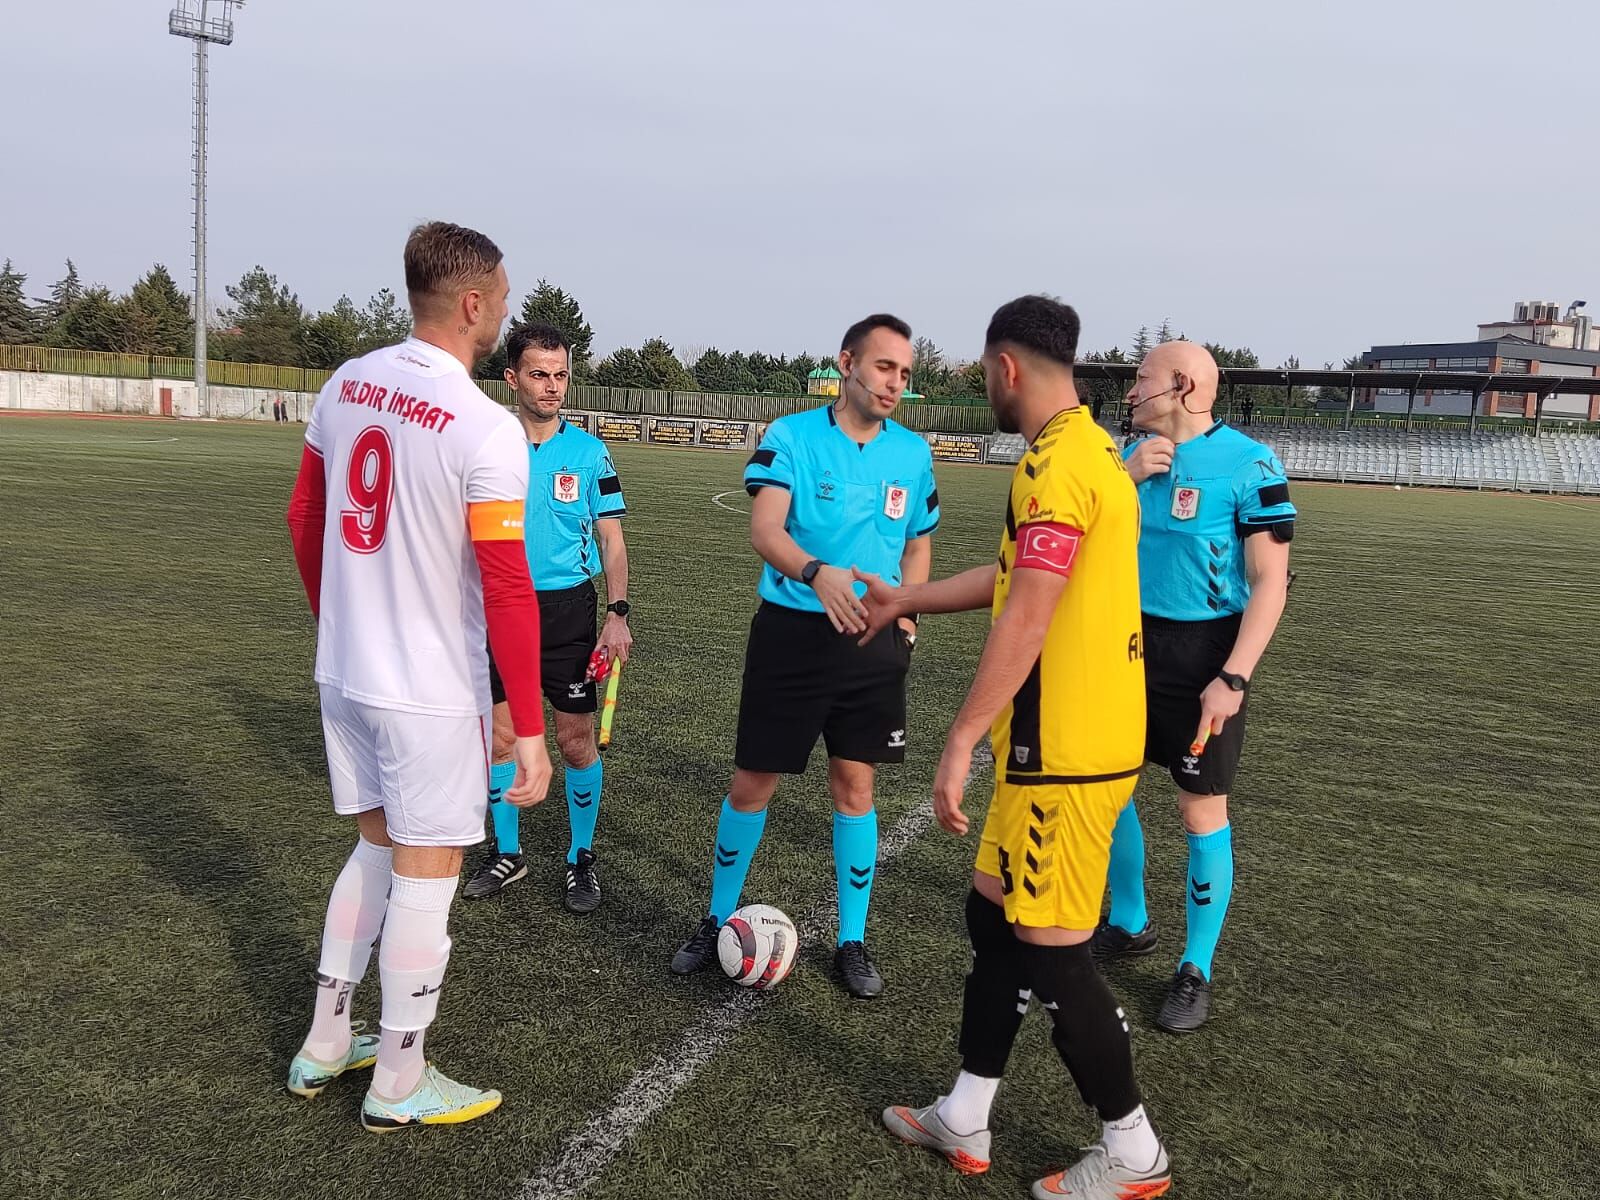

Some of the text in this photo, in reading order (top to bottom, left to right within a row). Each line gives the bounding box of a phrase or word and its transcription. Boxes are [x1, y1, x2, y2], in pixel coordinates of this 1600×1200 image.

[338, 379, 455, 434] YALDIR İNŞAAT
[340, 425, 395, 555] 9
[559, 492, 575, 500] TFF
[1175, 508, 1192, 517] TFF
